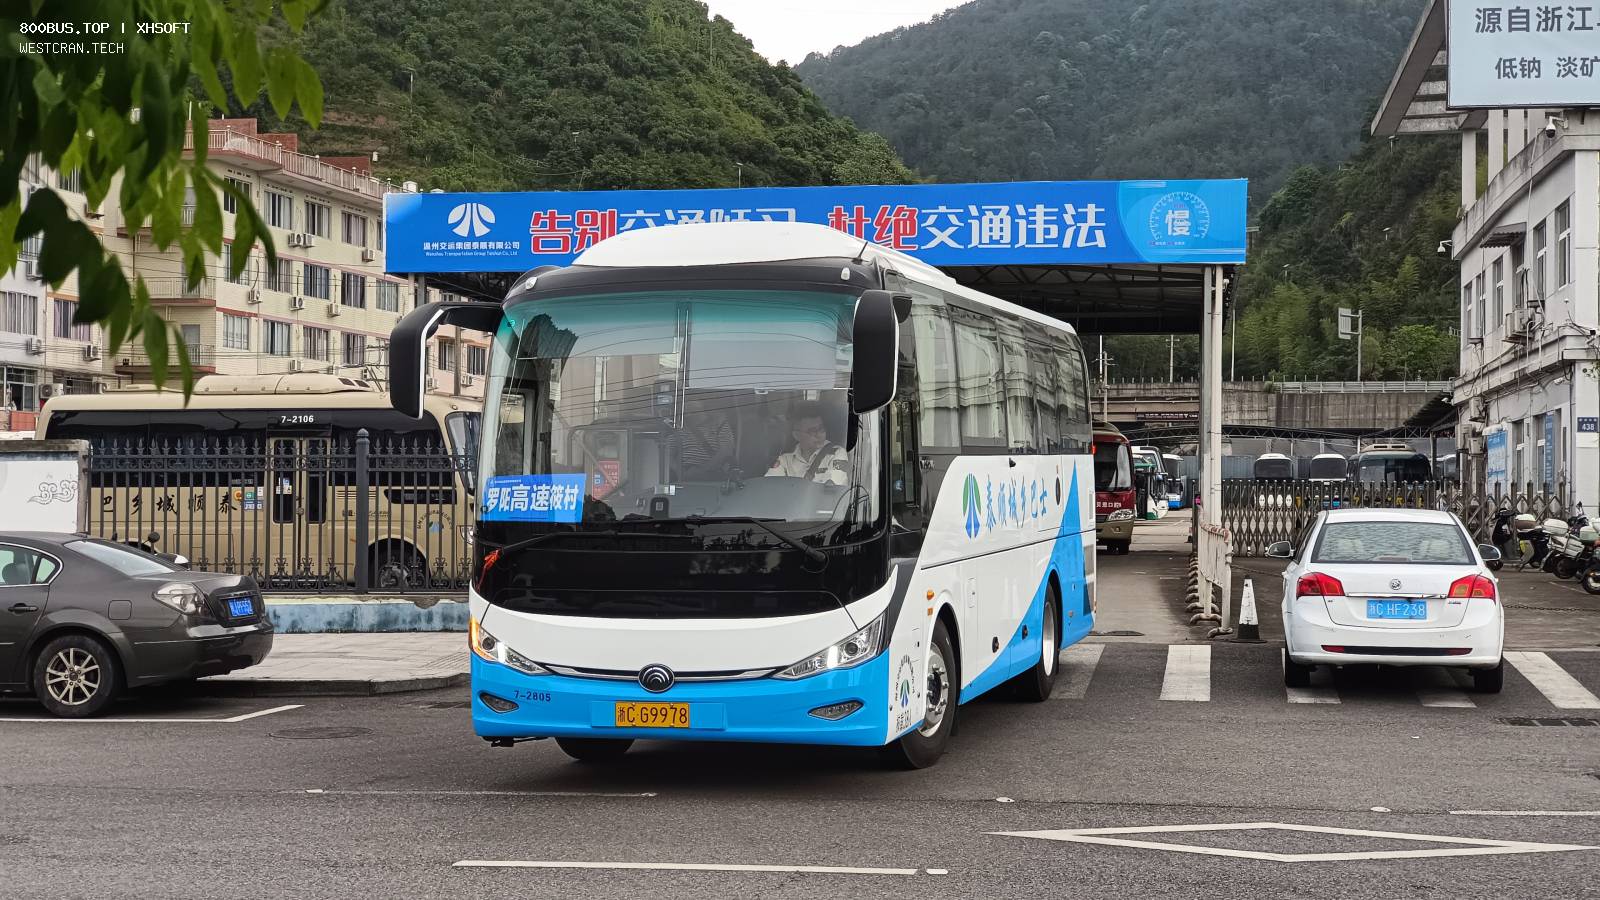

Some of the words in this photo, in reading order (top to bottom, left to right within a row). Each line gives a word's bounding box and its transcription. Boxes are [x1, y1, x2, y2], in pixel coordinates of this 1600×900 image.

[1475, 6, 1600, 33] 源自浙江
[1495, 57, 1541, 79] 低钠
[1165, 210, 1191, 235] 慢
[281, 415, 314, 424] 7-2106
[1582, 423, 1595, 431] 438
[985, 474, 1048, 534] 泰顺城乡巴士
[514, 690, 551, 701] 7-2805
